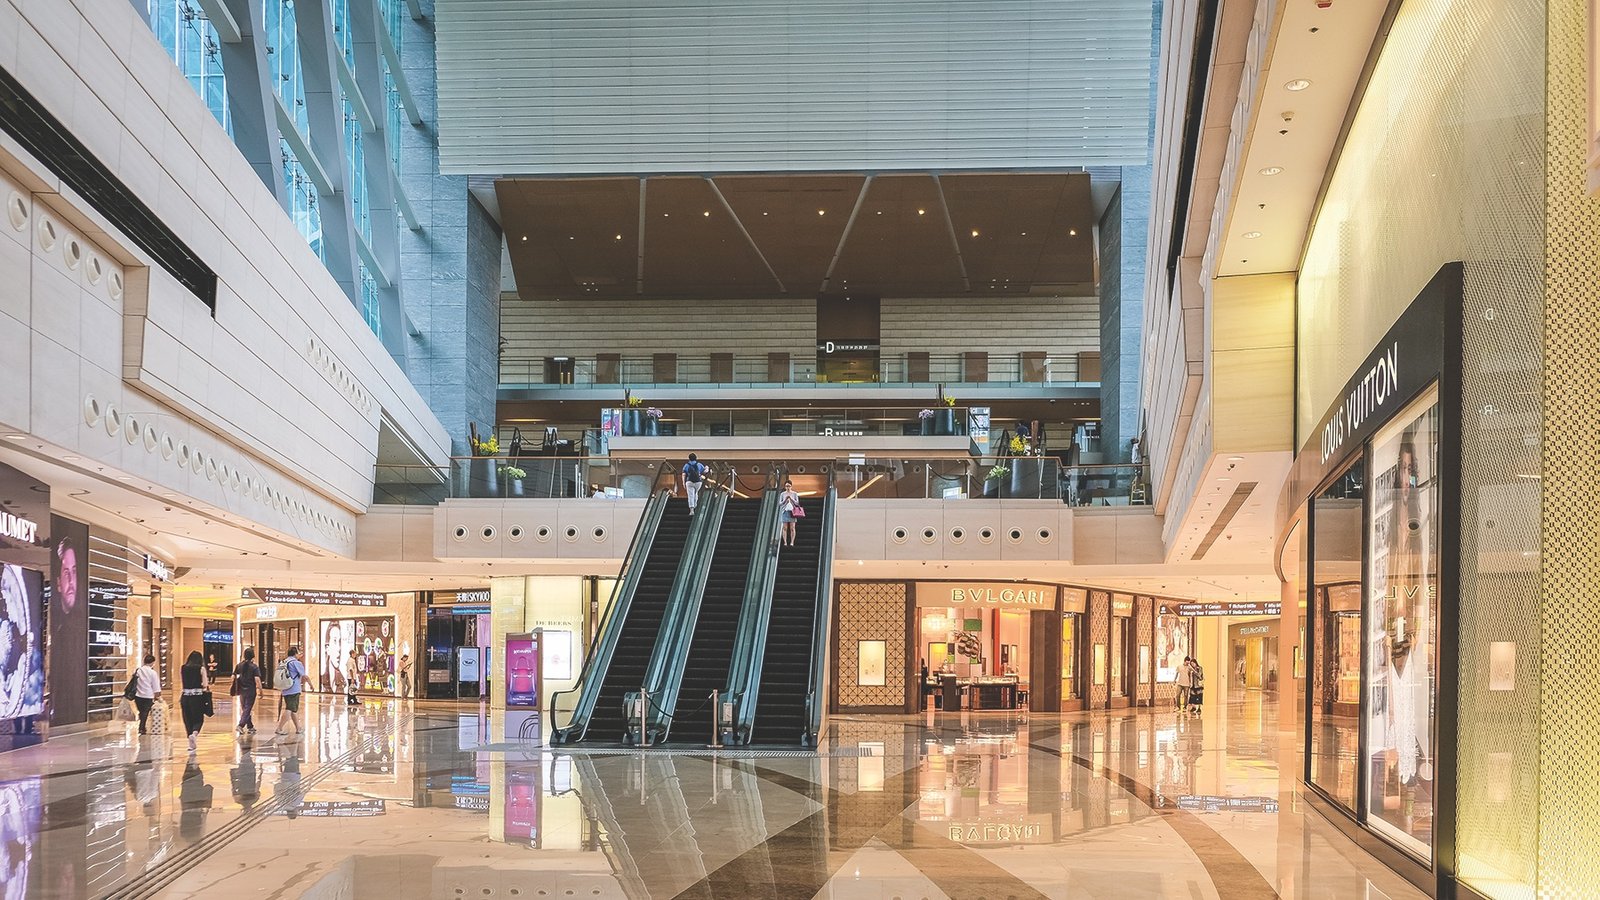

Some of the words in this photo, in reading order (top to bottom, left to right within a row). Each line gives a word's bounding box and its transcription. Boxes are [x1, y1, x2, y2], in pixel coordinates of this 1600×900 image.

[826, 342, 835, 353] D
[1321, 405, 1343, 464] LOUIS
[1346, 341, 1398, 438] VUITTON
[469, 591, 490, 602] SKY100
[950, 588, 1045, 604] BVLGARI
